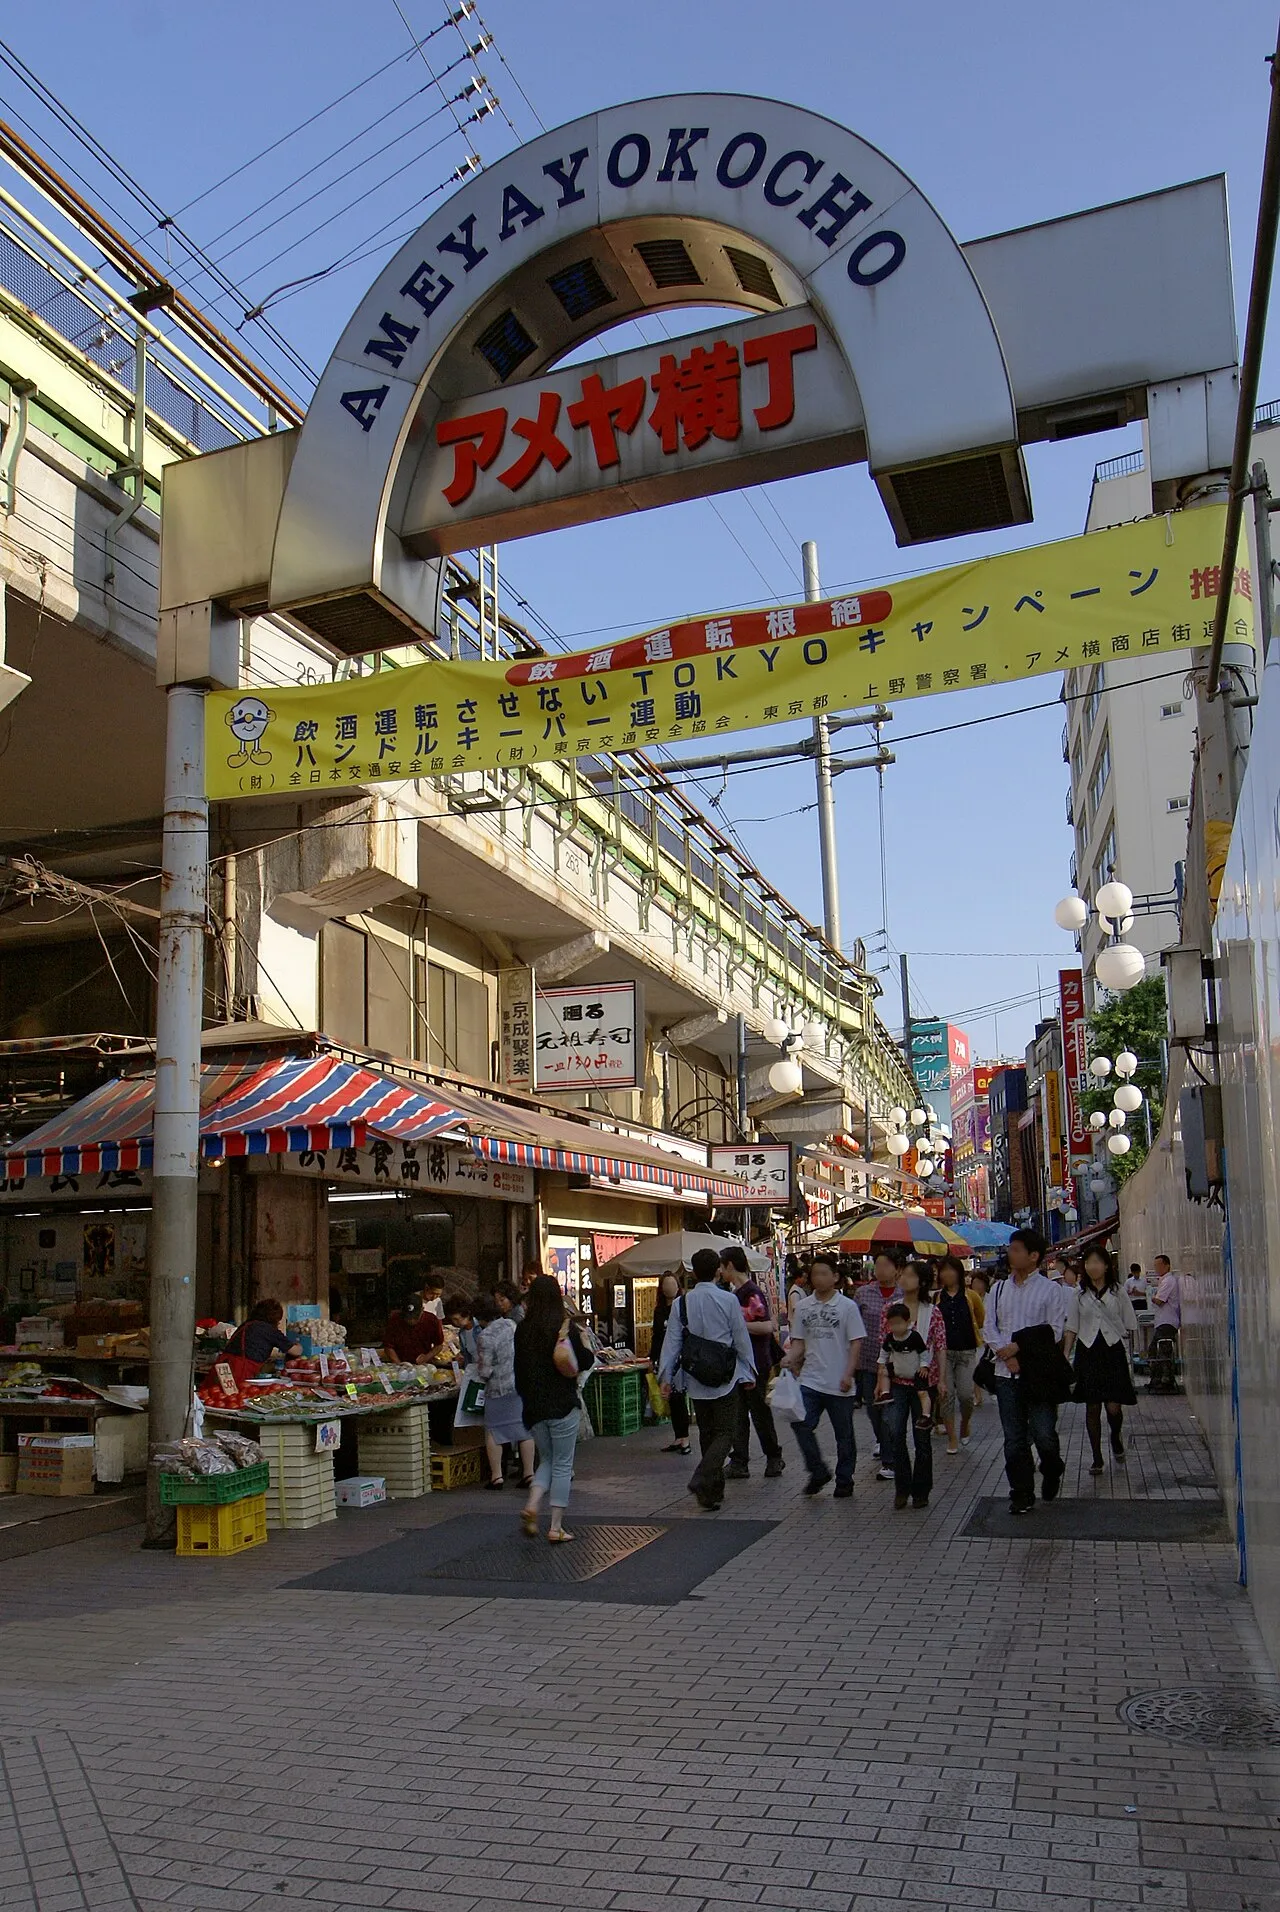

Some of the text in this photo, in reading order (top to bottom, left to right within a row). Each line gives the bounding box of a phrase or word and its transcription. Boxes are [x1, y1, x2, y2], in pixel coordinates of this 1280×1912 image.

[340, 127, 906, 432] AMEYAYOKOCHO
[436, 324, 817, 507] アメヤ横丁
[527, 597, 862, 683] 飲酒運転根絶
[295, 691, 702, 767] ハンドルキーパー運動
[511, 1000, 530, 1076] 京成聚楽
[536, 1027, 633, 1050] 元祖寿司
[993, 1133, 1005, 1188] GAME
